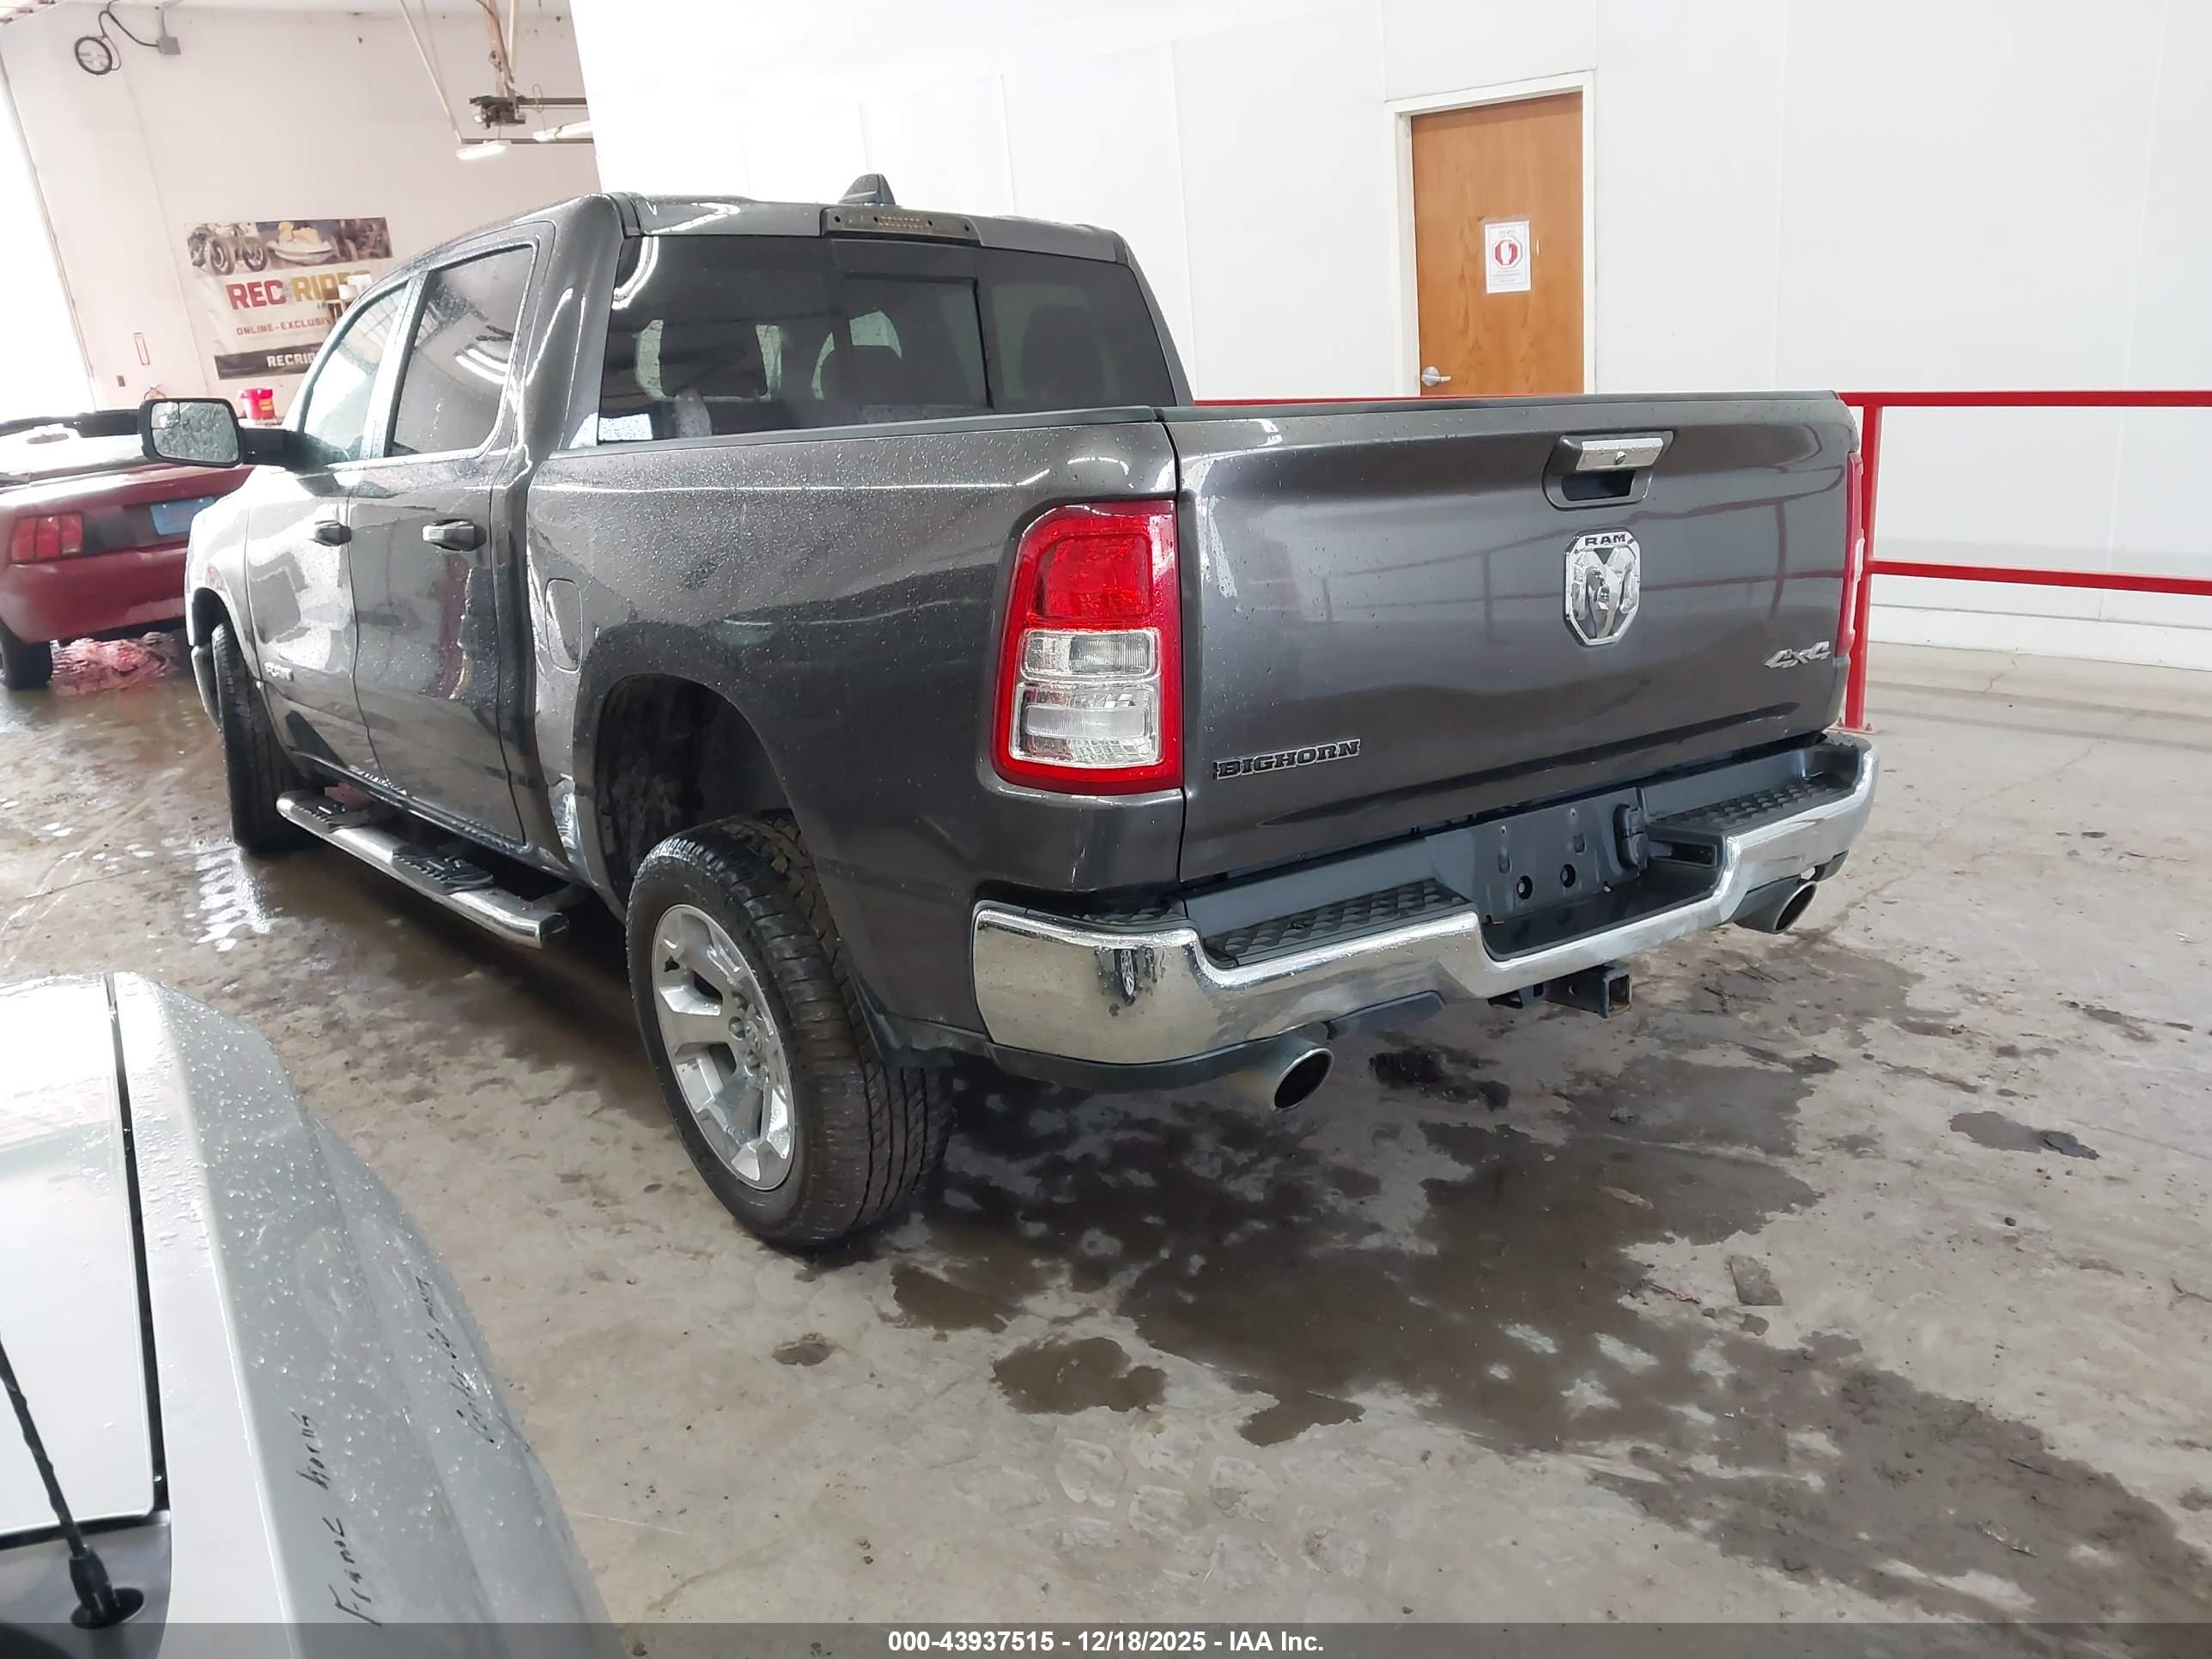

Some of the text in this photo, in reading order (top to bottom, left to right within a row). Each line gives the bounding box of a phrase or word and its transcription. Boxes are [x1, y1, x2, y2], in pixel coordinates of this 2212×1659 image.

[225, 270, 370, 309] REC RID
[236, 318, 332, 336] ONLINE-EXCLUSIV
[266, 353, 317, 368] RECRID
[1584, 533, 1626, 546] RAM
[1214, 738, 1361, 780] BIGHORN
